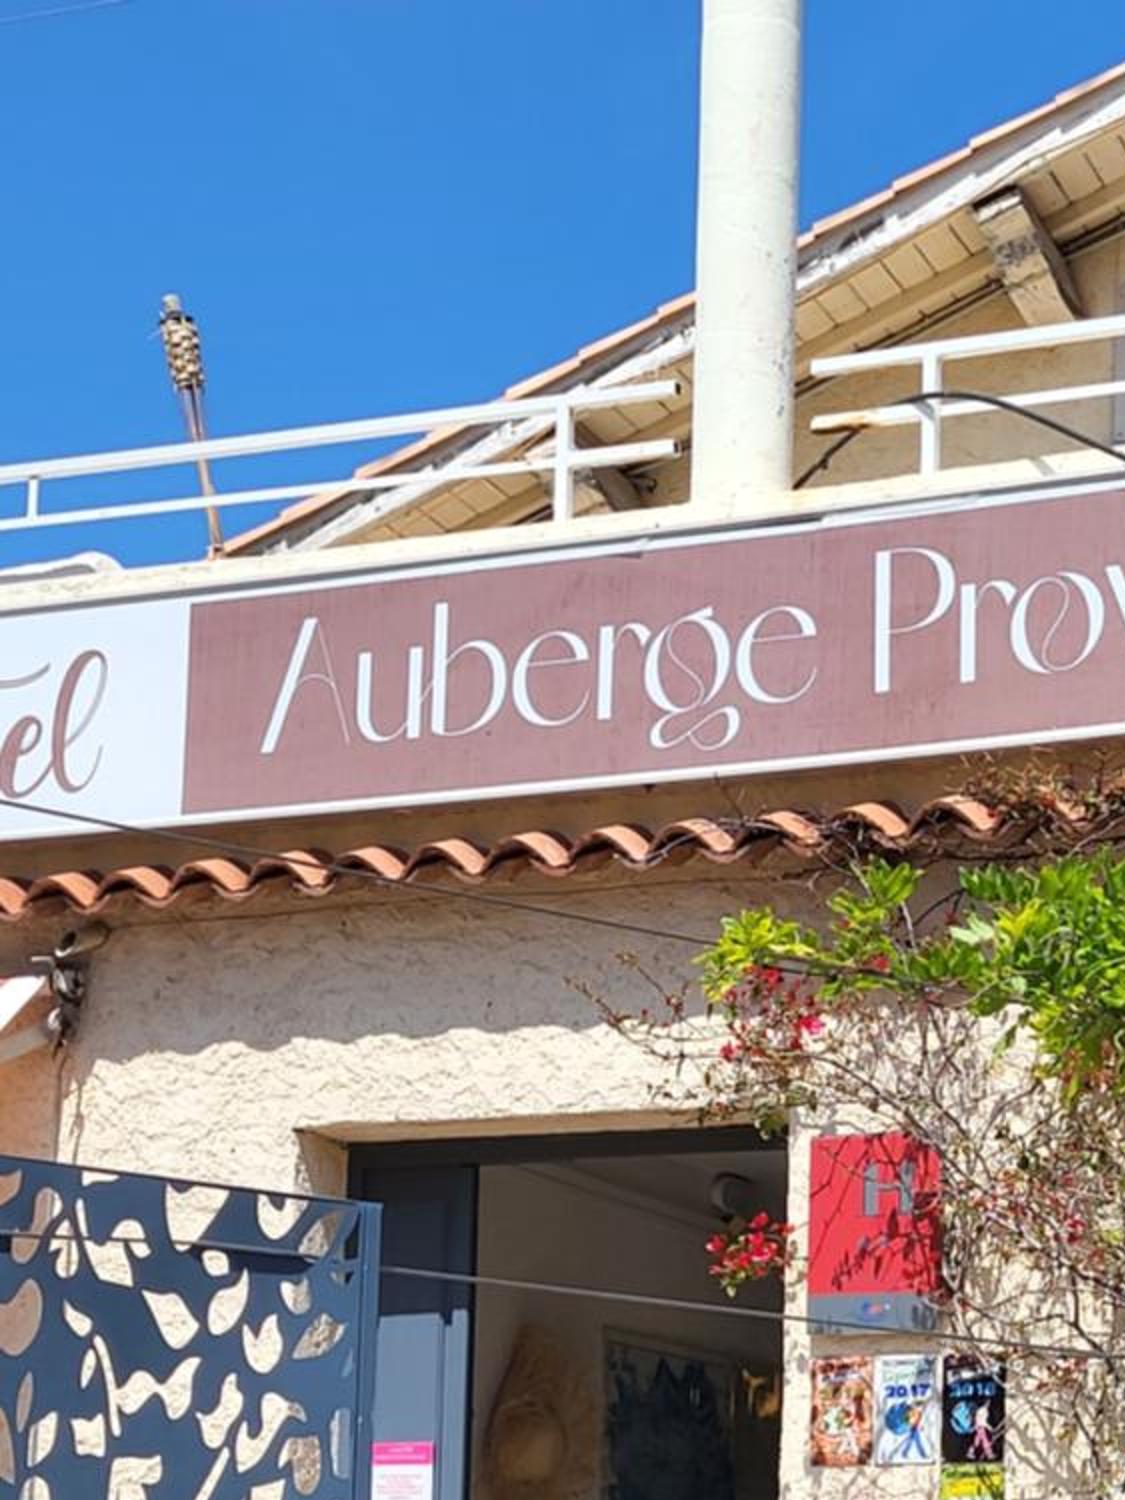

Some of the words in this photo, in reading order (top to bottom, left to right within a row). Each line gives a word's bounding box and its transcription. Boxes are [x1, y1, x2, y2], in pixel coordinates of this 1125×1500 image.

[0, 648, 108, 799] el
[260, 602, 818, 754] Auberge
[884, 1383, 930, 1398] 2017
